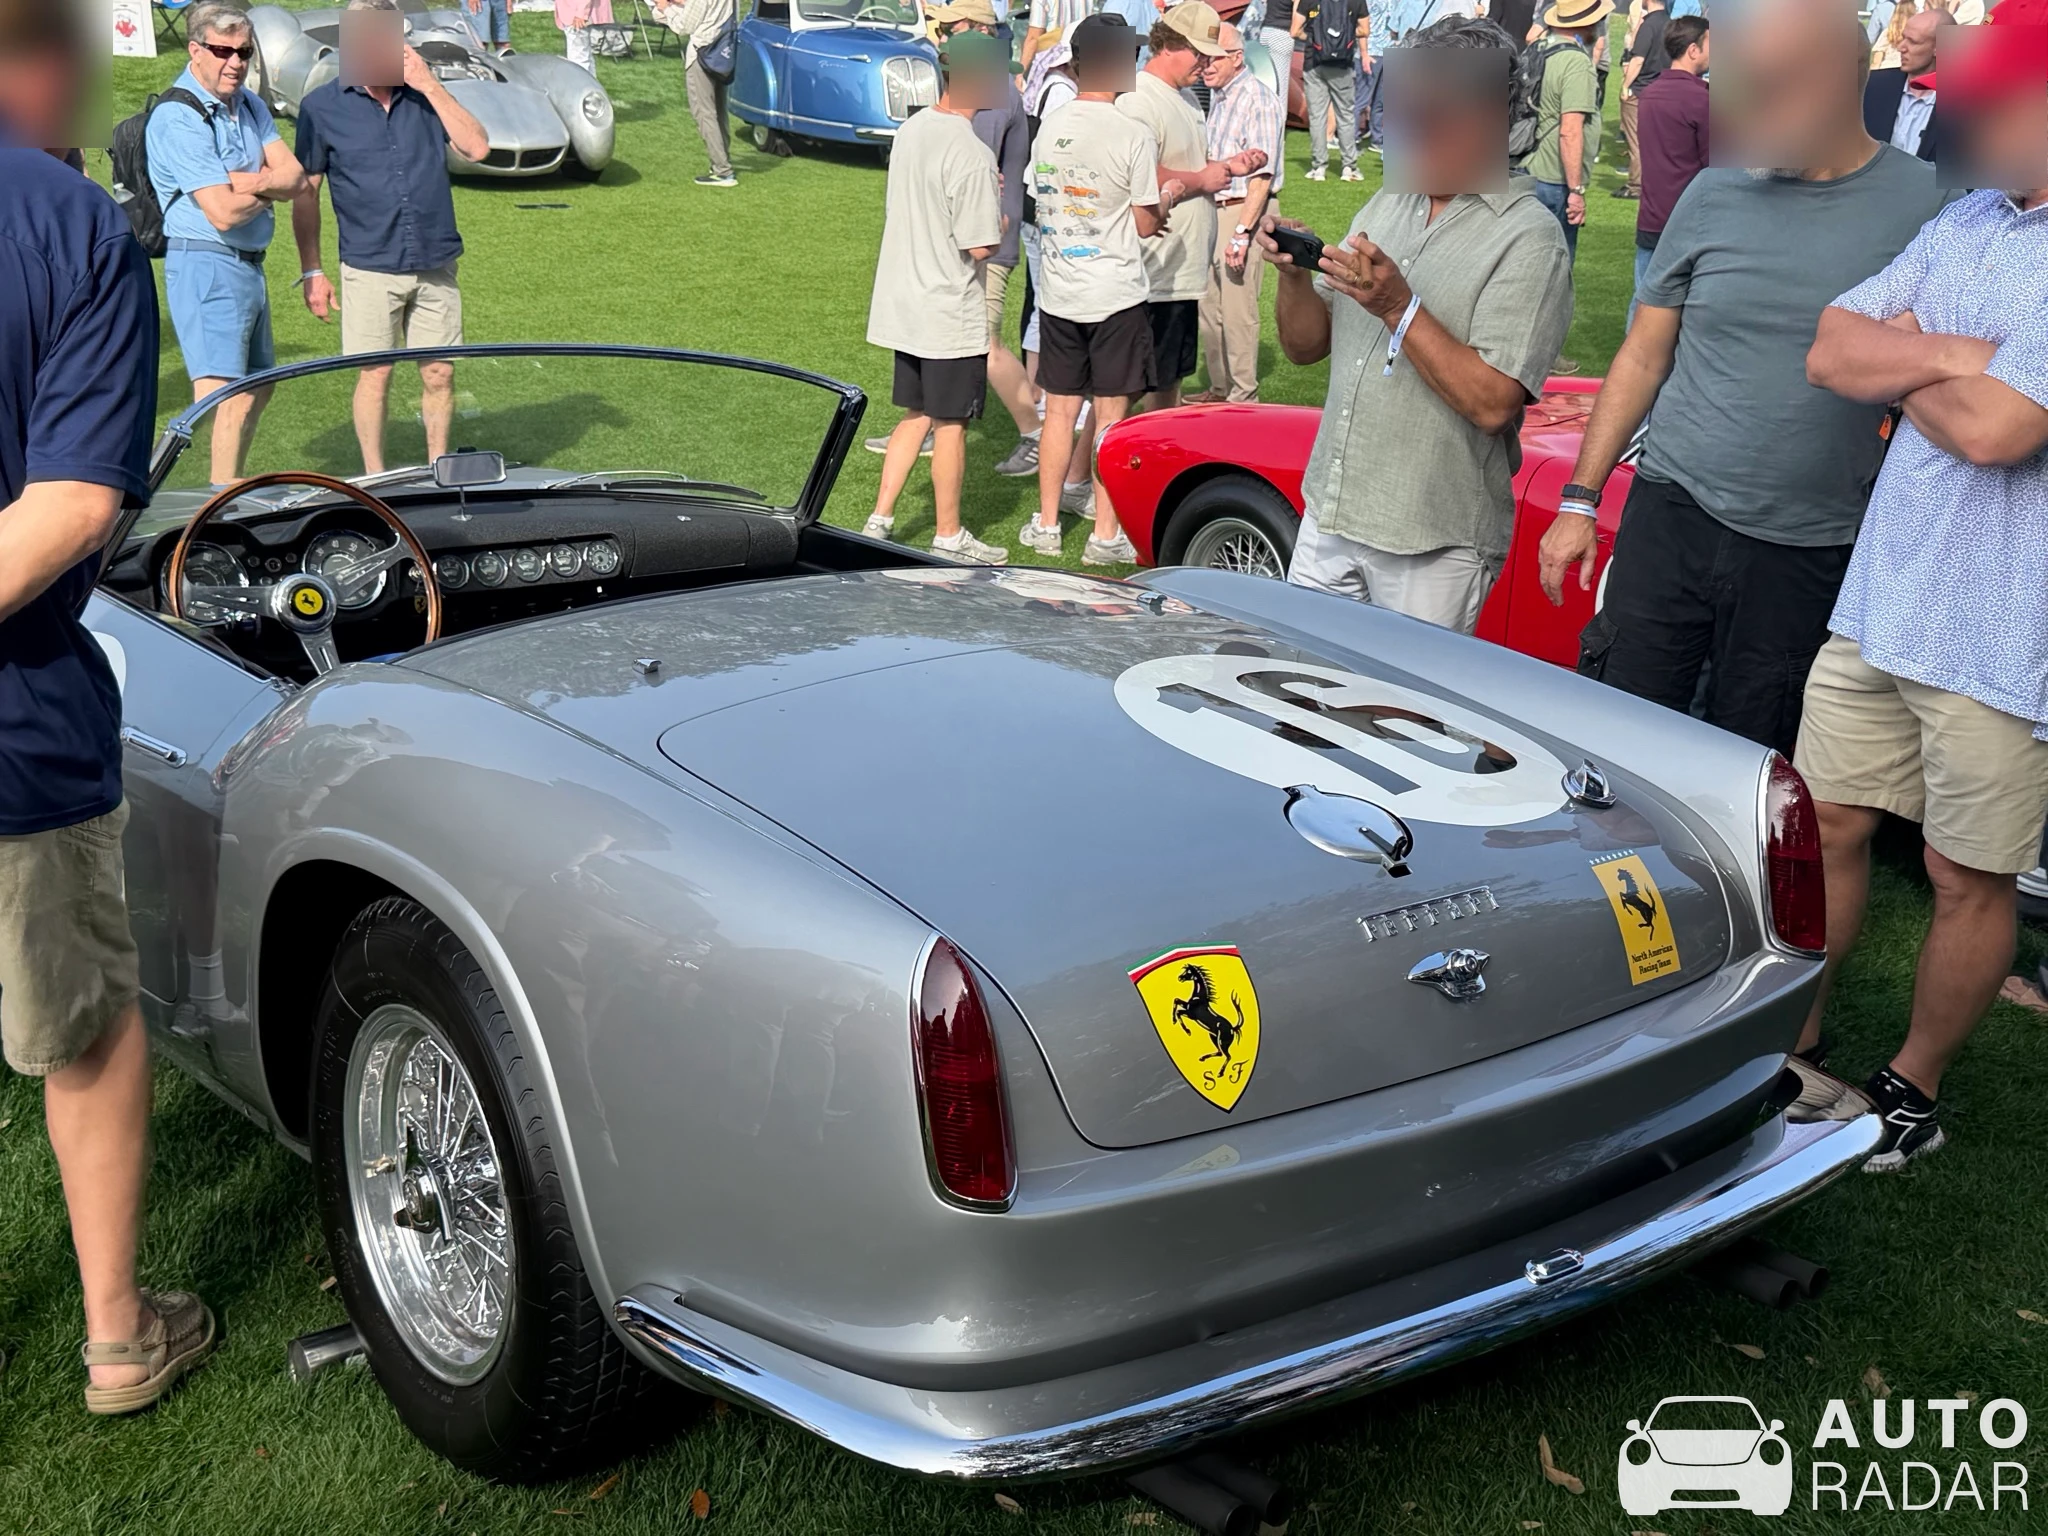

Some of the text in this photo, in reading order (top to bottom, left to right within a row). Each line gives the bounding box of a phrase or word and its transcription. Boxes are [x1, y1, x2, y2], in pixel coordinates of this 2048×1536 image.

[1055, 138, 1074, 148] RUF
[1157, 671, 1518, 796] 16
[1356, 885, 1500, 943] Ferrari
[1631, 945, 1673, 964] North American
[1639, 959, 1671, 974] Racing Team
[1203, 1059, 1250, 1091] S F
